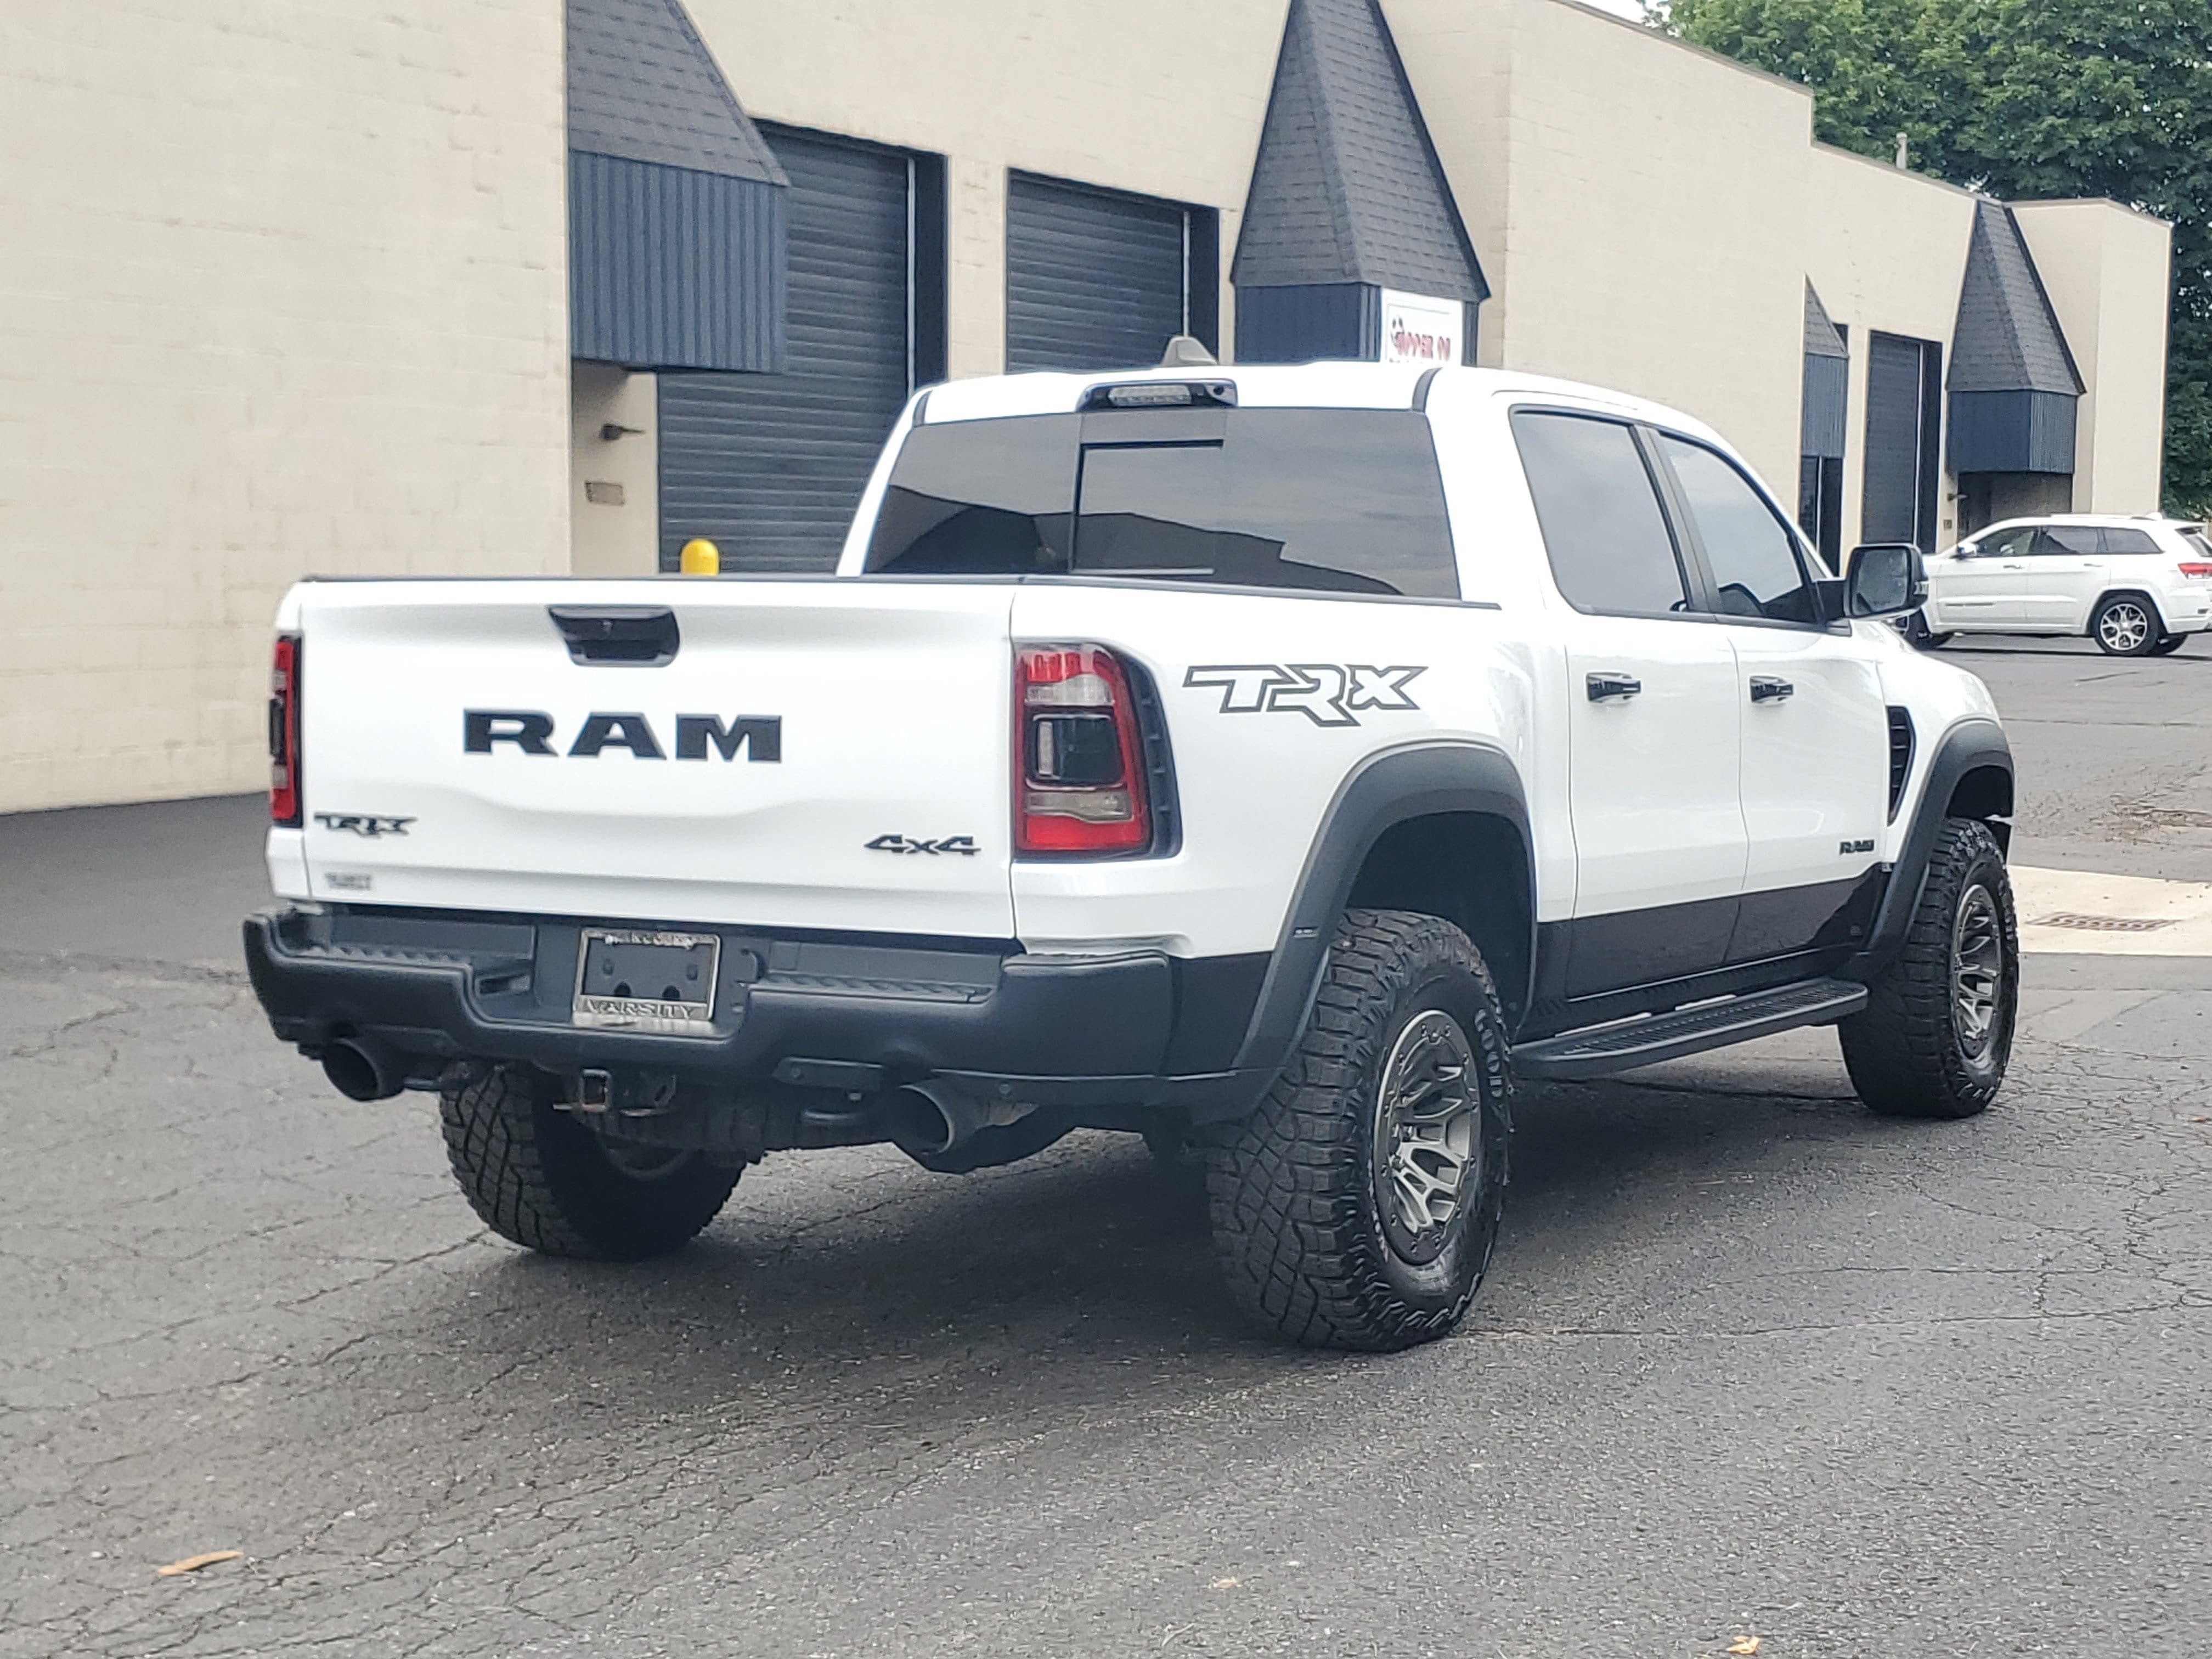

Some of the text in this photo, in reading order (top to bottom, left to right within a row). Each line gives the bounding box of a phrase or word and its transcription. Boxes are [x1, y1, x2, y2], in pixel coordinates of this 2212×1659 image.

[1182, 663, 1430, 727] TRX
[463, 708, 782, 763] RAM
[314, 812, 418, 838] TRX
[864, 834, 981, 856] 4x4
[1839, 839, 1875, 856] RAM
[586, 998, 696, 1020] VARSITY
